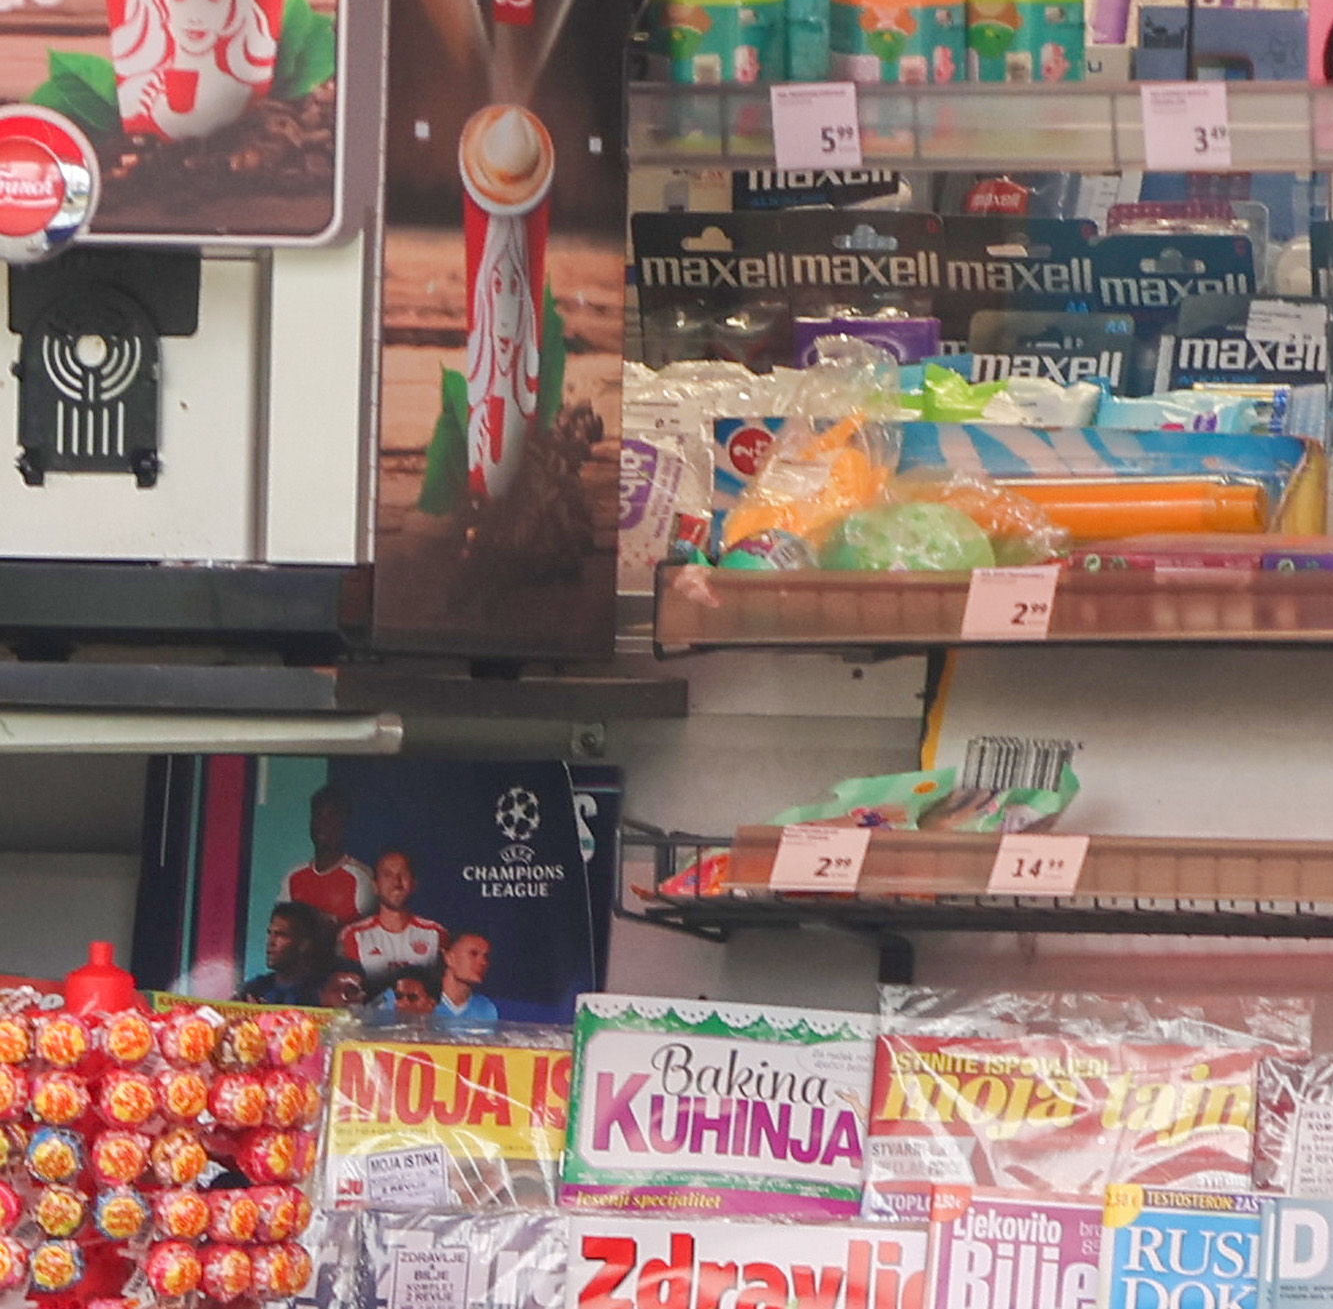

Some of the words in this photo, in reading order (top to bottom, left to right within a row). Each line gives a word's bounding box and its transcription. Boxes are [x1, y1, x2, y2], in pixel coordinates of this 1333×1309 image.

[968, 192, 1021, 209] maxell
[642, 253, 786, 289] maxell
[793, 250, 939, 288] maxell
[947, 258, 1092, 292] maxell
[1101, 274, 1248, 308] maxell
[972, 351, 1122, 388] maxell
[1178, 335, 1327, 374] maxell
[500, 844, 535, 864] UEFA
[463, 864, 565, 882] CHAMPIONS
[482, 882, 549, 898] LEAGUE
[651, 1043, 832, 1107] Bakina
[897, 1052, 979, 1075] ISTINITE
[337, 1048, 511, 1128] MOJA
[592, 1070, 864, 1169] KUHINJA
[876, 1074, 1080, 1141] moja
[369, 1156, 402, 1172] MOJA
[404, 1150, 440, 1170] ISTINA
[576, 1192, 632, 1210] Jesenji
[636, 1191, 722, 1210] specijalitet
[1147, 1191, 1232, 1210] TESTOSTERON
[951, 1210, 1063, 1245] Ljekovito
[400, 1251, 466, 1265] ZDRAVLJE
[413, 1270, 449, 1283] BILJE
